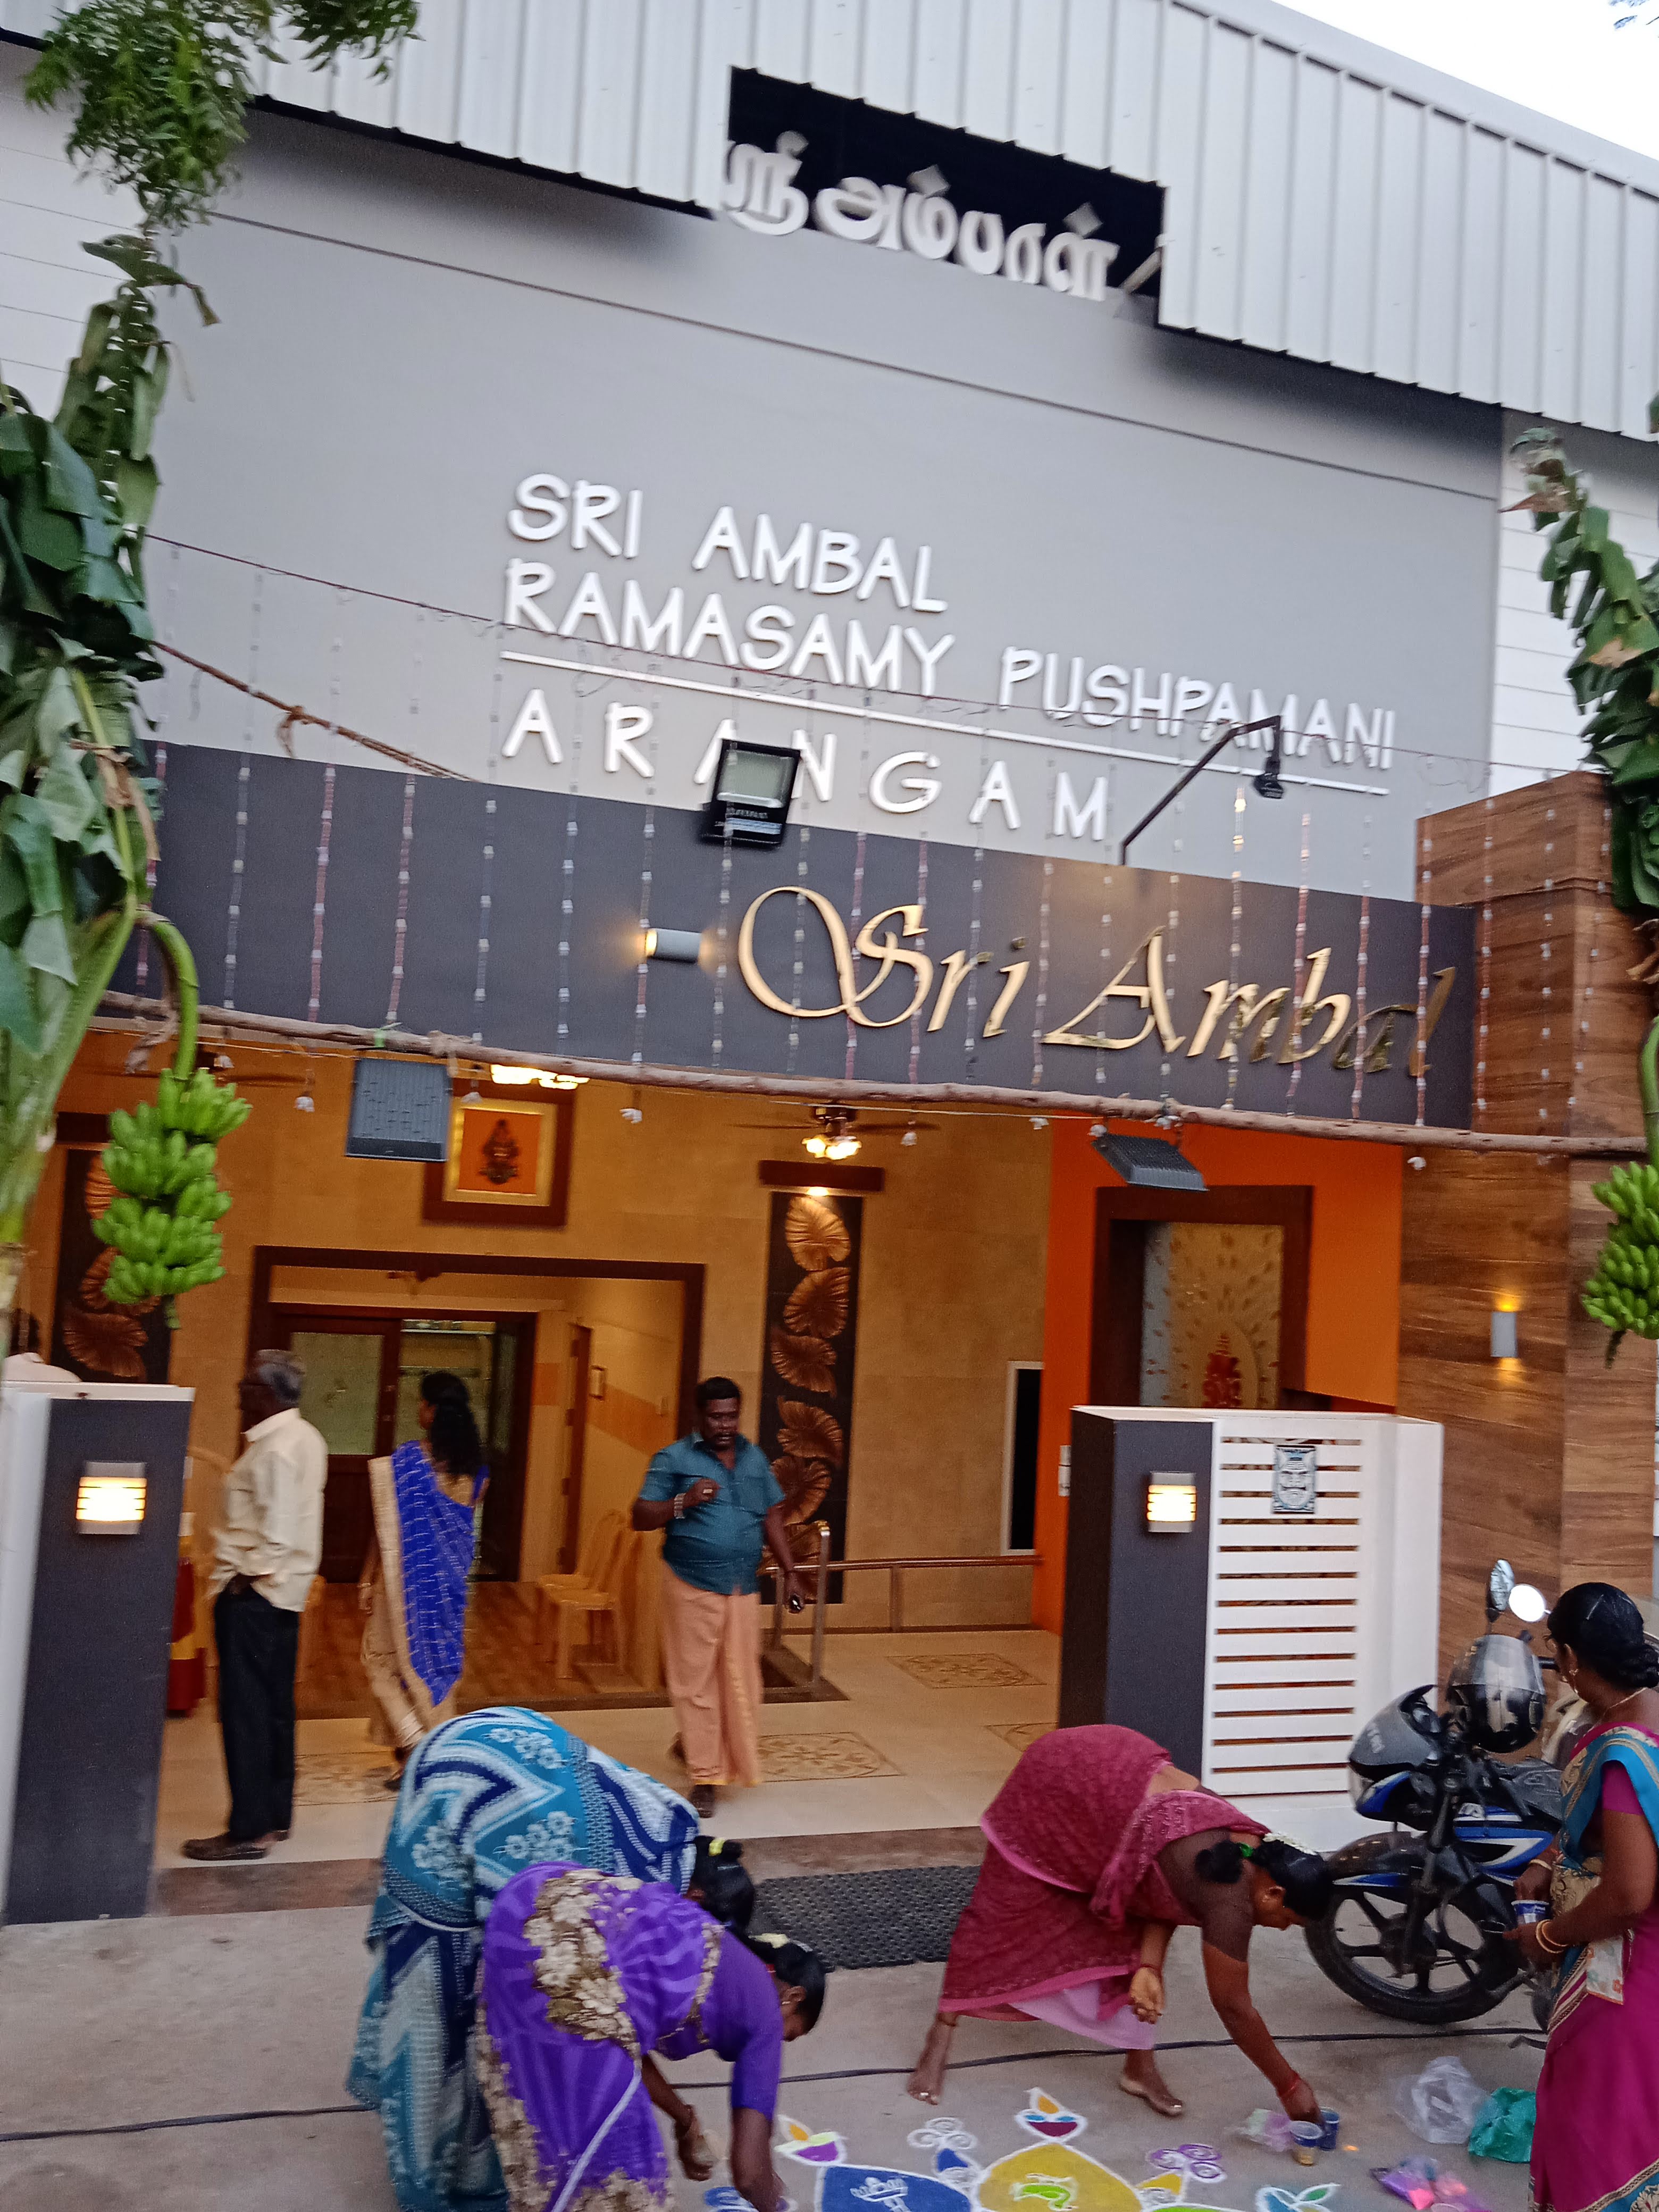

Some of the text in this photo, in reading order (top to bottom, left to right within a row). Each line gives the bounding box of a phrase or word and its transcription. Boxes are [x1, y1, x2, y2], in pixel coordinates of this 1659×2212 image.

[507, 473, 948, 613] SRI AMBAL
[504, 557, 1396, 770] RAMASAMY PUSHPAMANI
[738, 886, 1456, 1077] Sri Ambal
